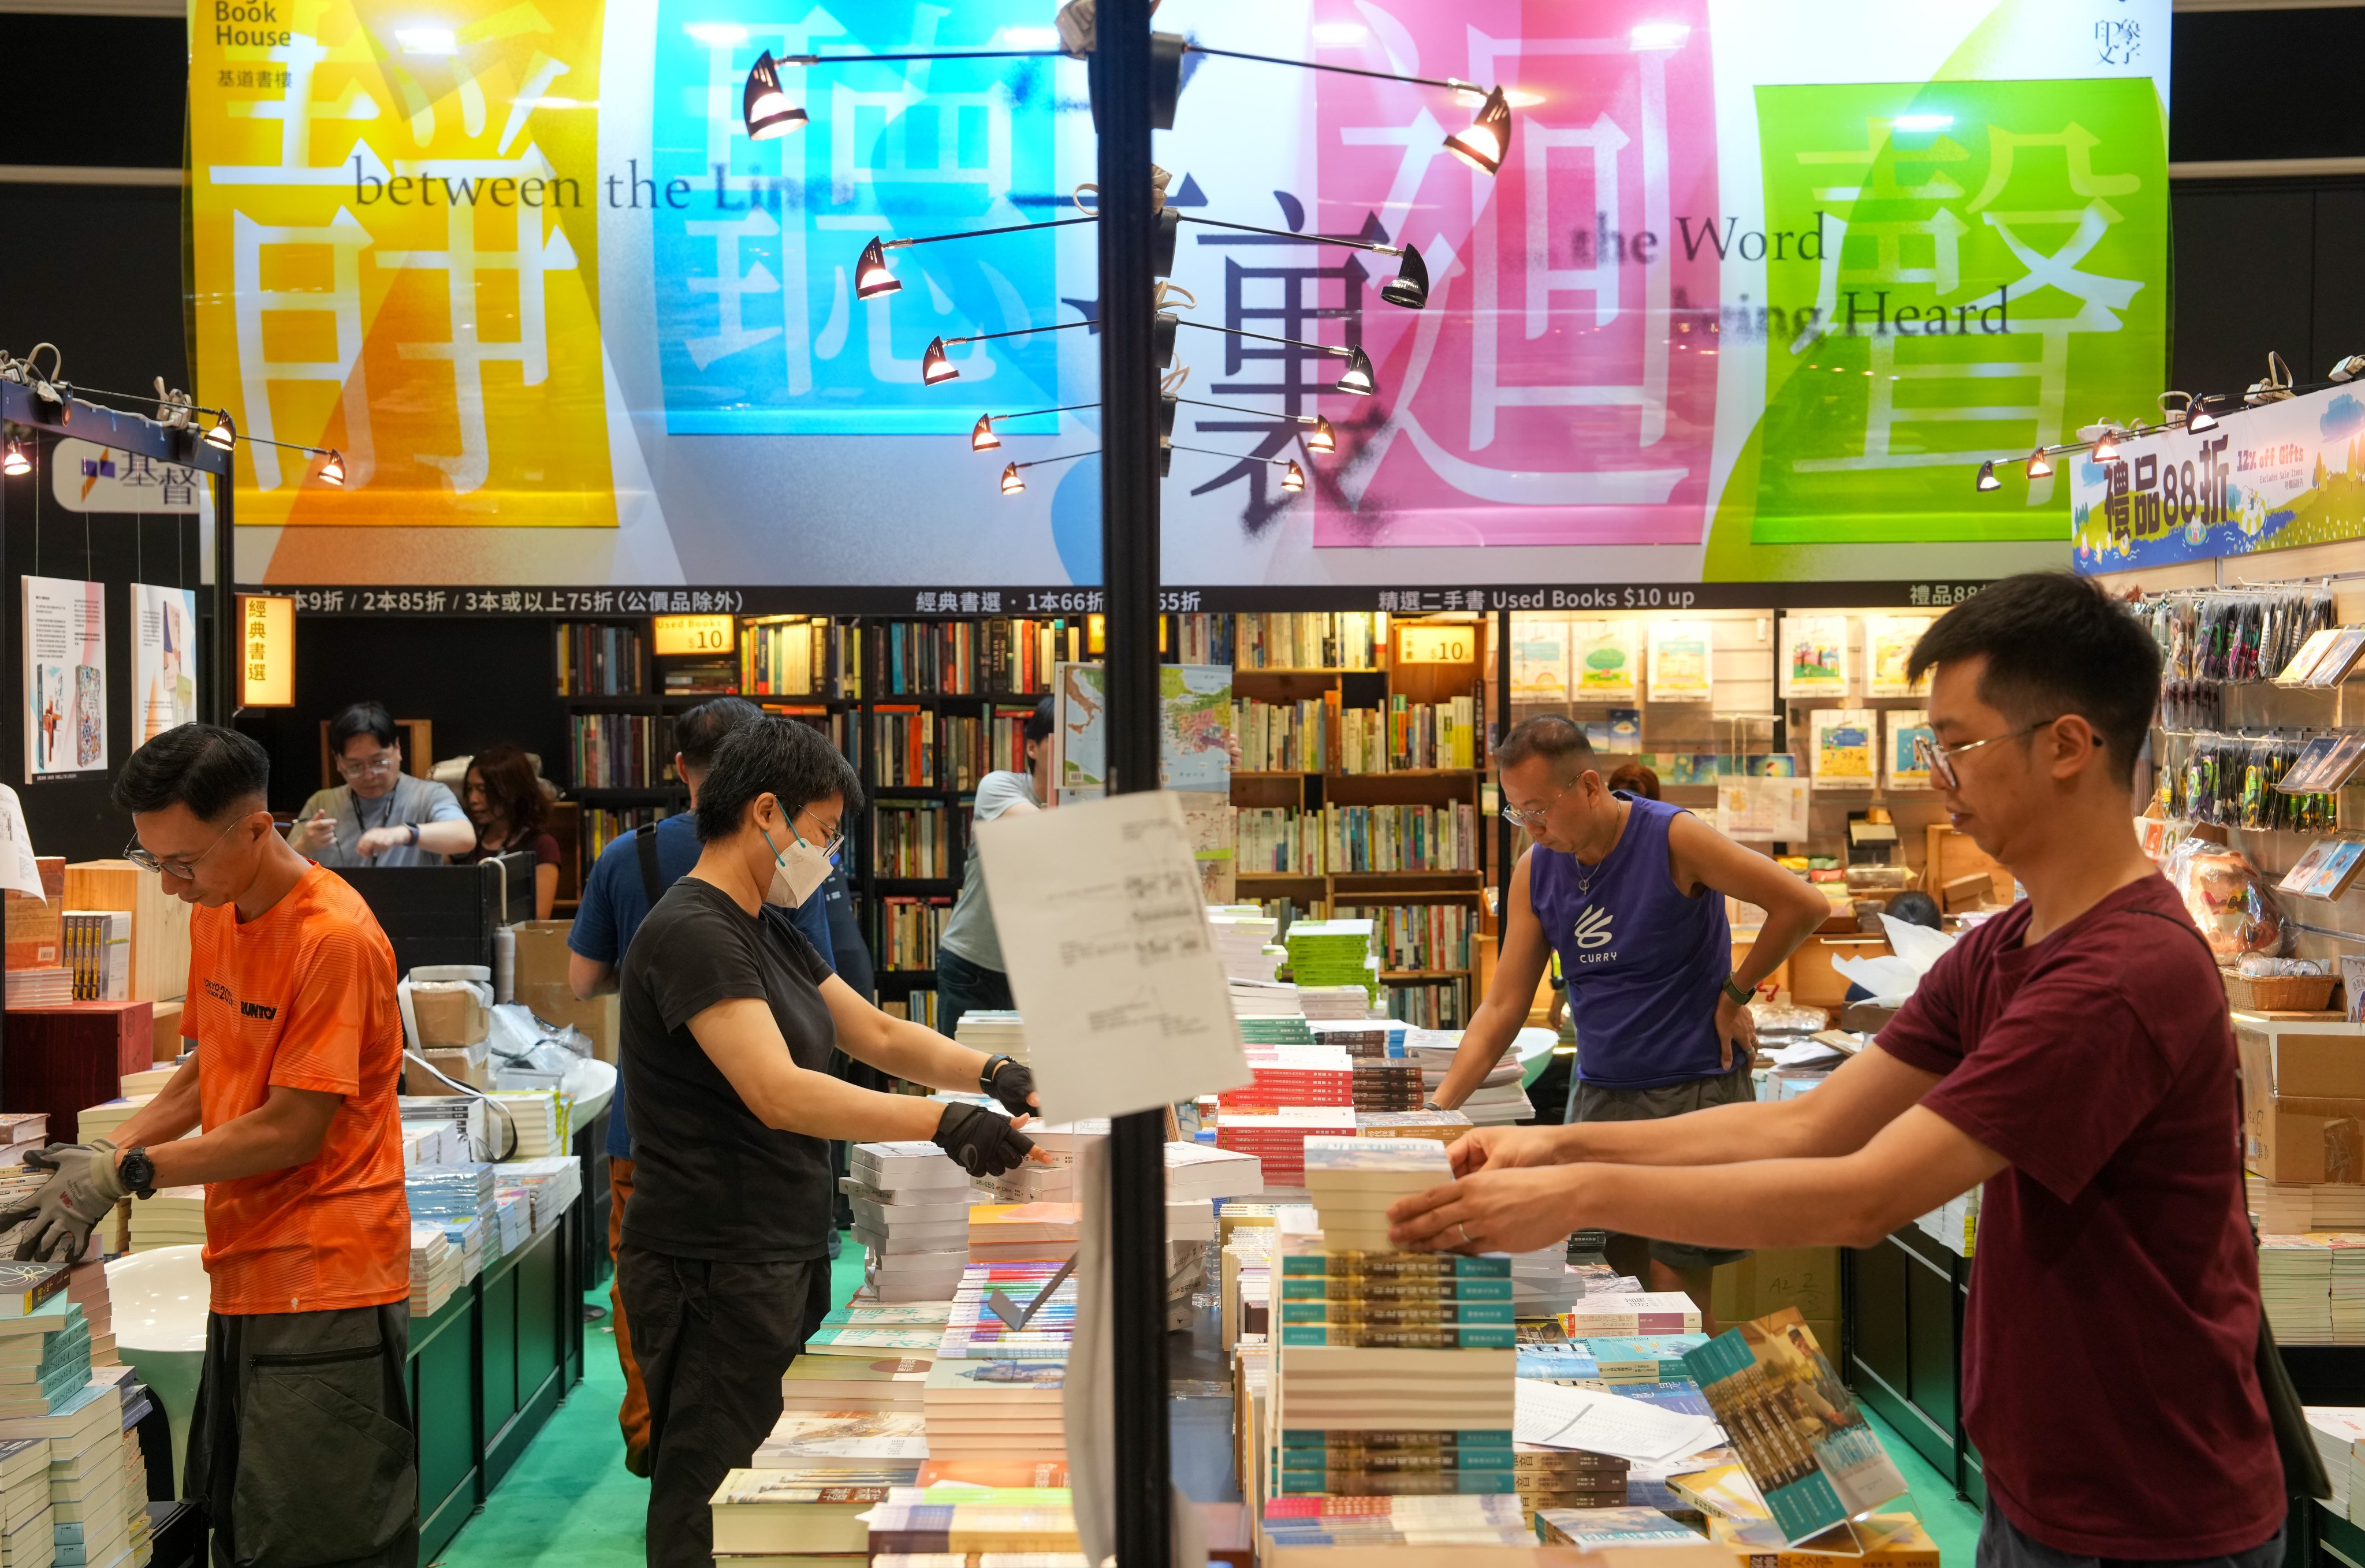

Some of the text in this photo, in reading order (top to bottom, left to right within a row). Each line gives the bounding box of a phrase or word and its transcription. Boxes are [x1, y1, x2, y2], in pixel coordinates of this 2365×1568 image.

[216, 1, 277, 23] Book
[216, 25, 292, 47] House
[217, 69, 292, 89] 基道書樓
[352, 155, 583, 208] between
[604, 159, 691, 210] the
[1675, 210, 1829, 263] Word
[1842, 284, 2013, 336] Heard
[2237, 443, 2304, 472] 12% off Gifts
[119, 450, 200, 507] 基督
[2103, 433, 2230, 541] 禮品88折
[2259, 468, 2304, 484] Excludes Sale Items
[363, 590, 446, 613] 2本85折
[915, 591, 1003, 613] 經典書選
[1378, 586, 1696, 612] 精選二手書 Used Books $10 up
[657, 618, 722, 629] Used Books
[248, 599, 267, 682] 經典書選
[1580, 951, 1618, 963] CURRY
[59, 1190, 74, 1209] 3M
